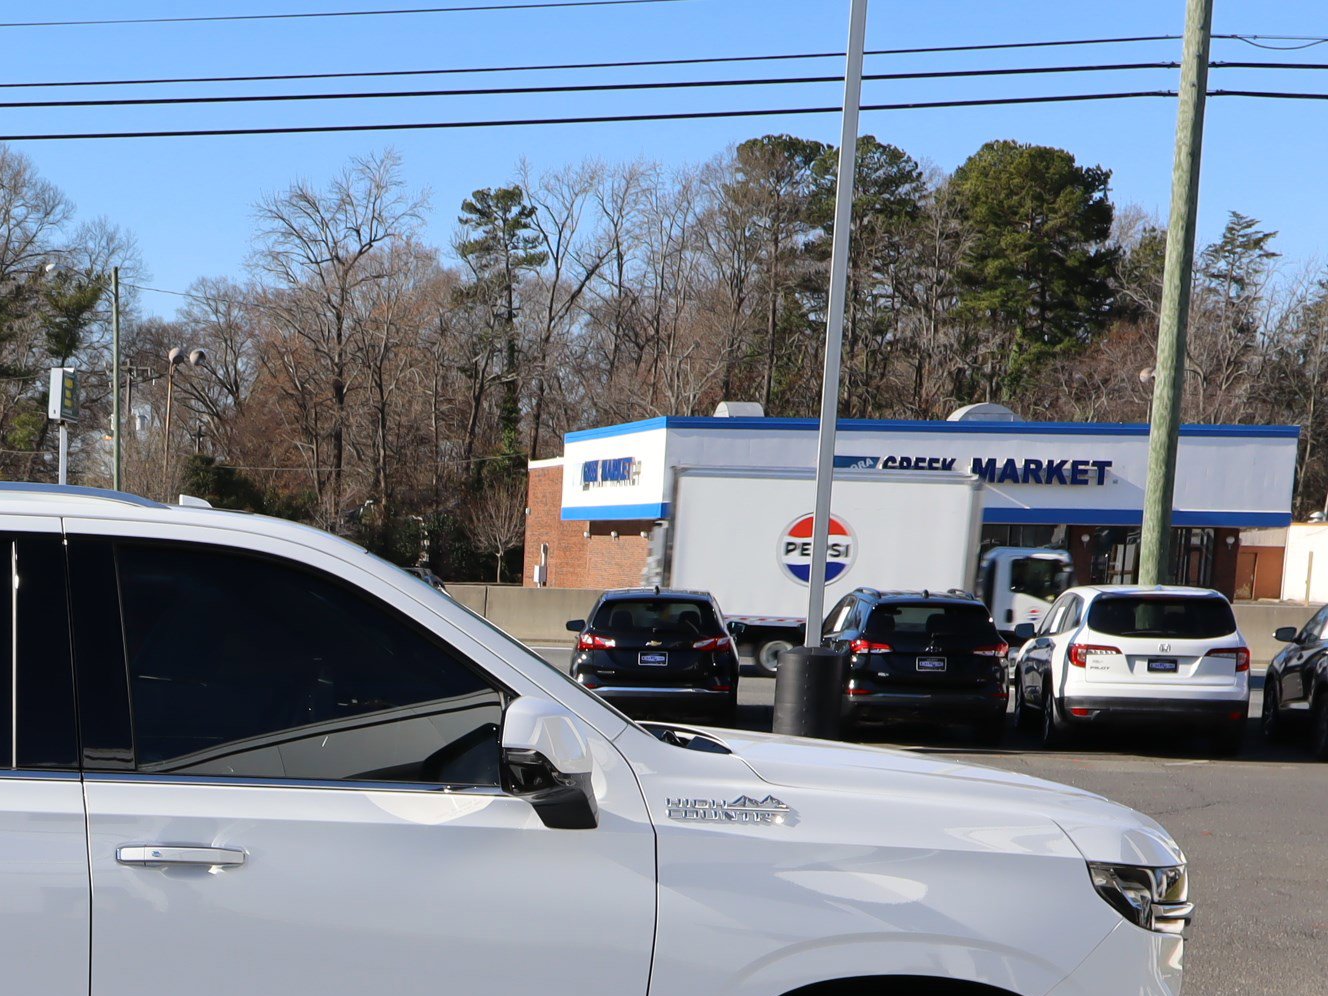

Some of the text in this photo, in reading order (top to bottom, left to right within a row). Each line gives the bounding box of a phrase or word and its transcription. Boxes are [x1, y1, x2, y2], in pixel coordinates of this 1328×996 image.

[970, 457, 1113, 486] MARKET
[784, 541, 849, 558] PESI
[664, 809, 784, 824] COUNTR
